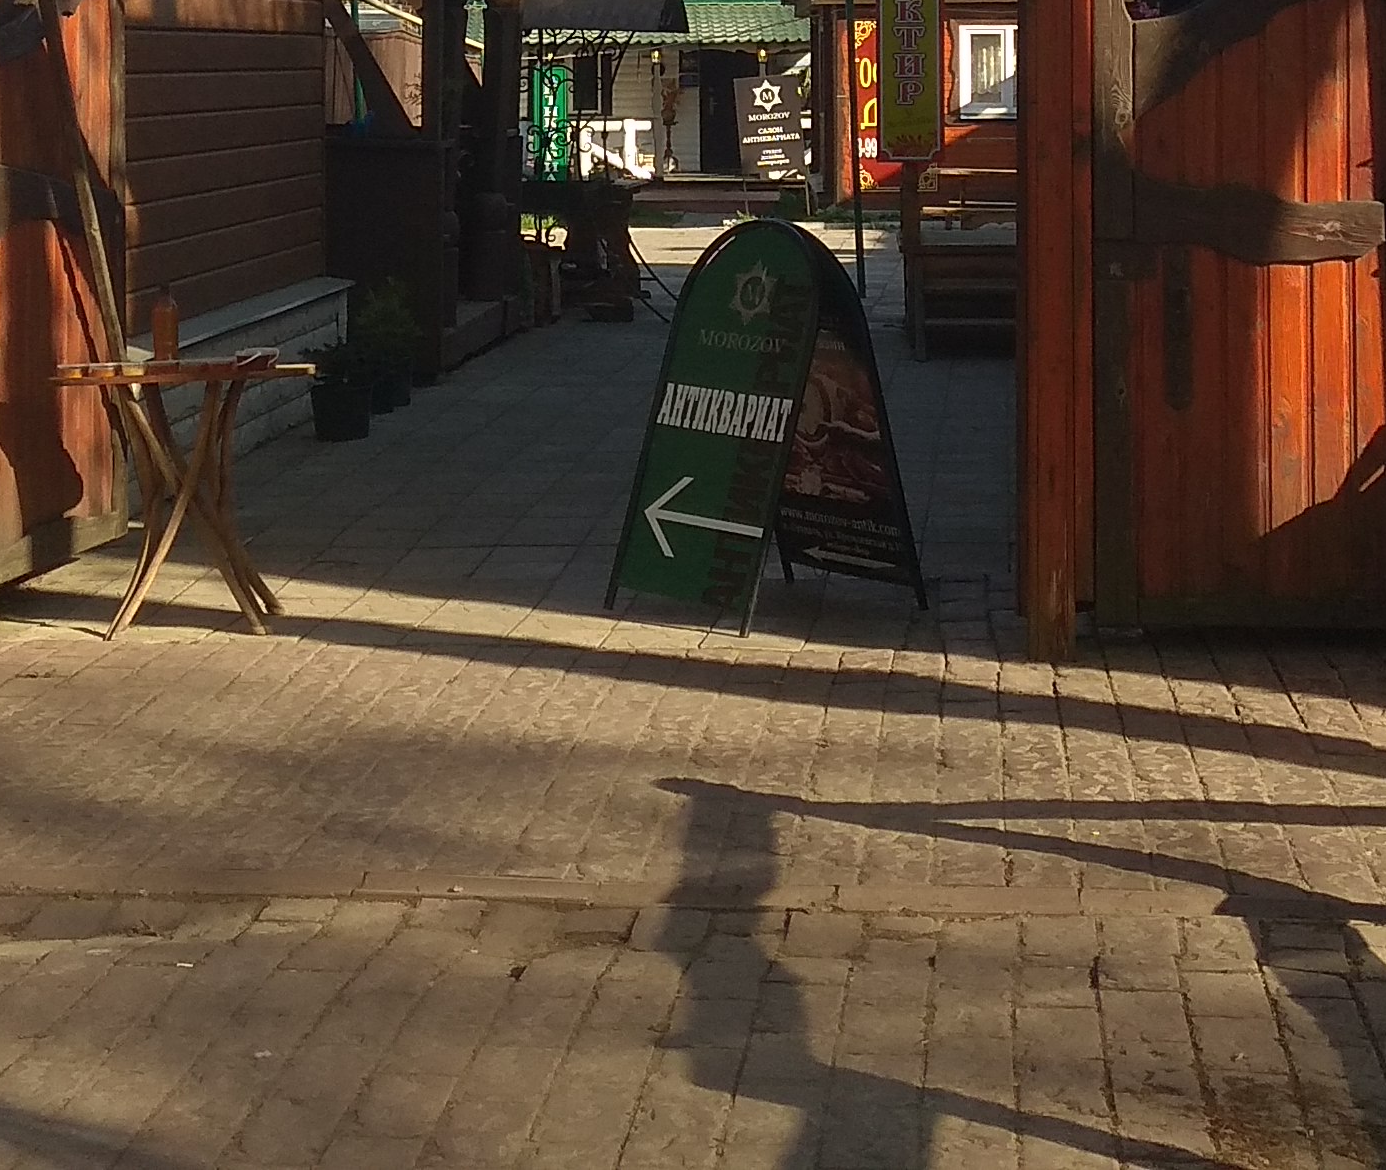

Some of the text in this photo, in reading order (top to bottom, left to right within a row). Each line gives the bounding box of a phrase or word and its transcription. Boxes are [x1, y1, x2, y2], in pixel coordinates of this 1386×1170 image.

[748, 112, 790, 121] MOROZOV
[699, 328, 786, 354] MOROZOV
[656, 382, 794, 443] АНТИКВАРИАТ
